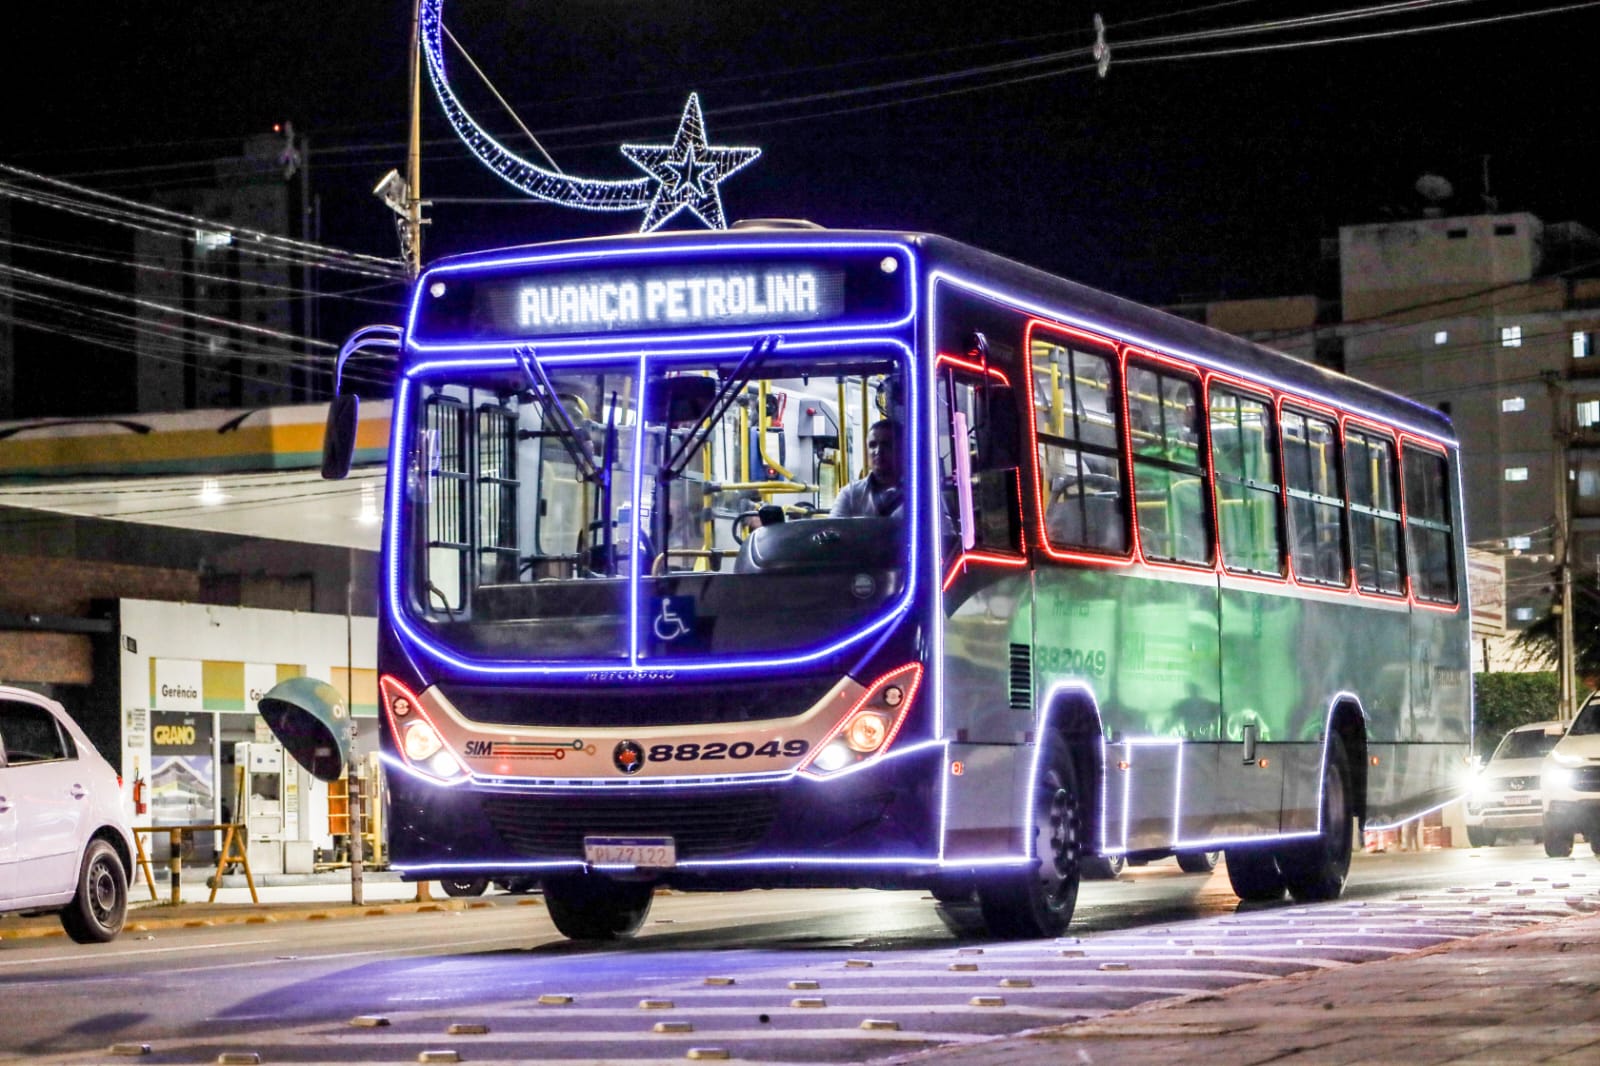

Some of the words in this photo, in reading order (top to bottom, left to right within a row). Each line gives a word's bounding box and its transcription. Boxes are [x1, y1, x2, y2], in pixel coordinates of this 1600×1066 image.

[518, 282, 640, 329] AVANÇA
[646, 272, 818, 320] PETROLINA
[1036, 645, 1106, 676] 882049
[161, 684, 198, 699] Gerência
[153, 725, 196, 746] GRANO
[464, 740, 493, 756] SIM
[647, 739, 811, 763] 882049
